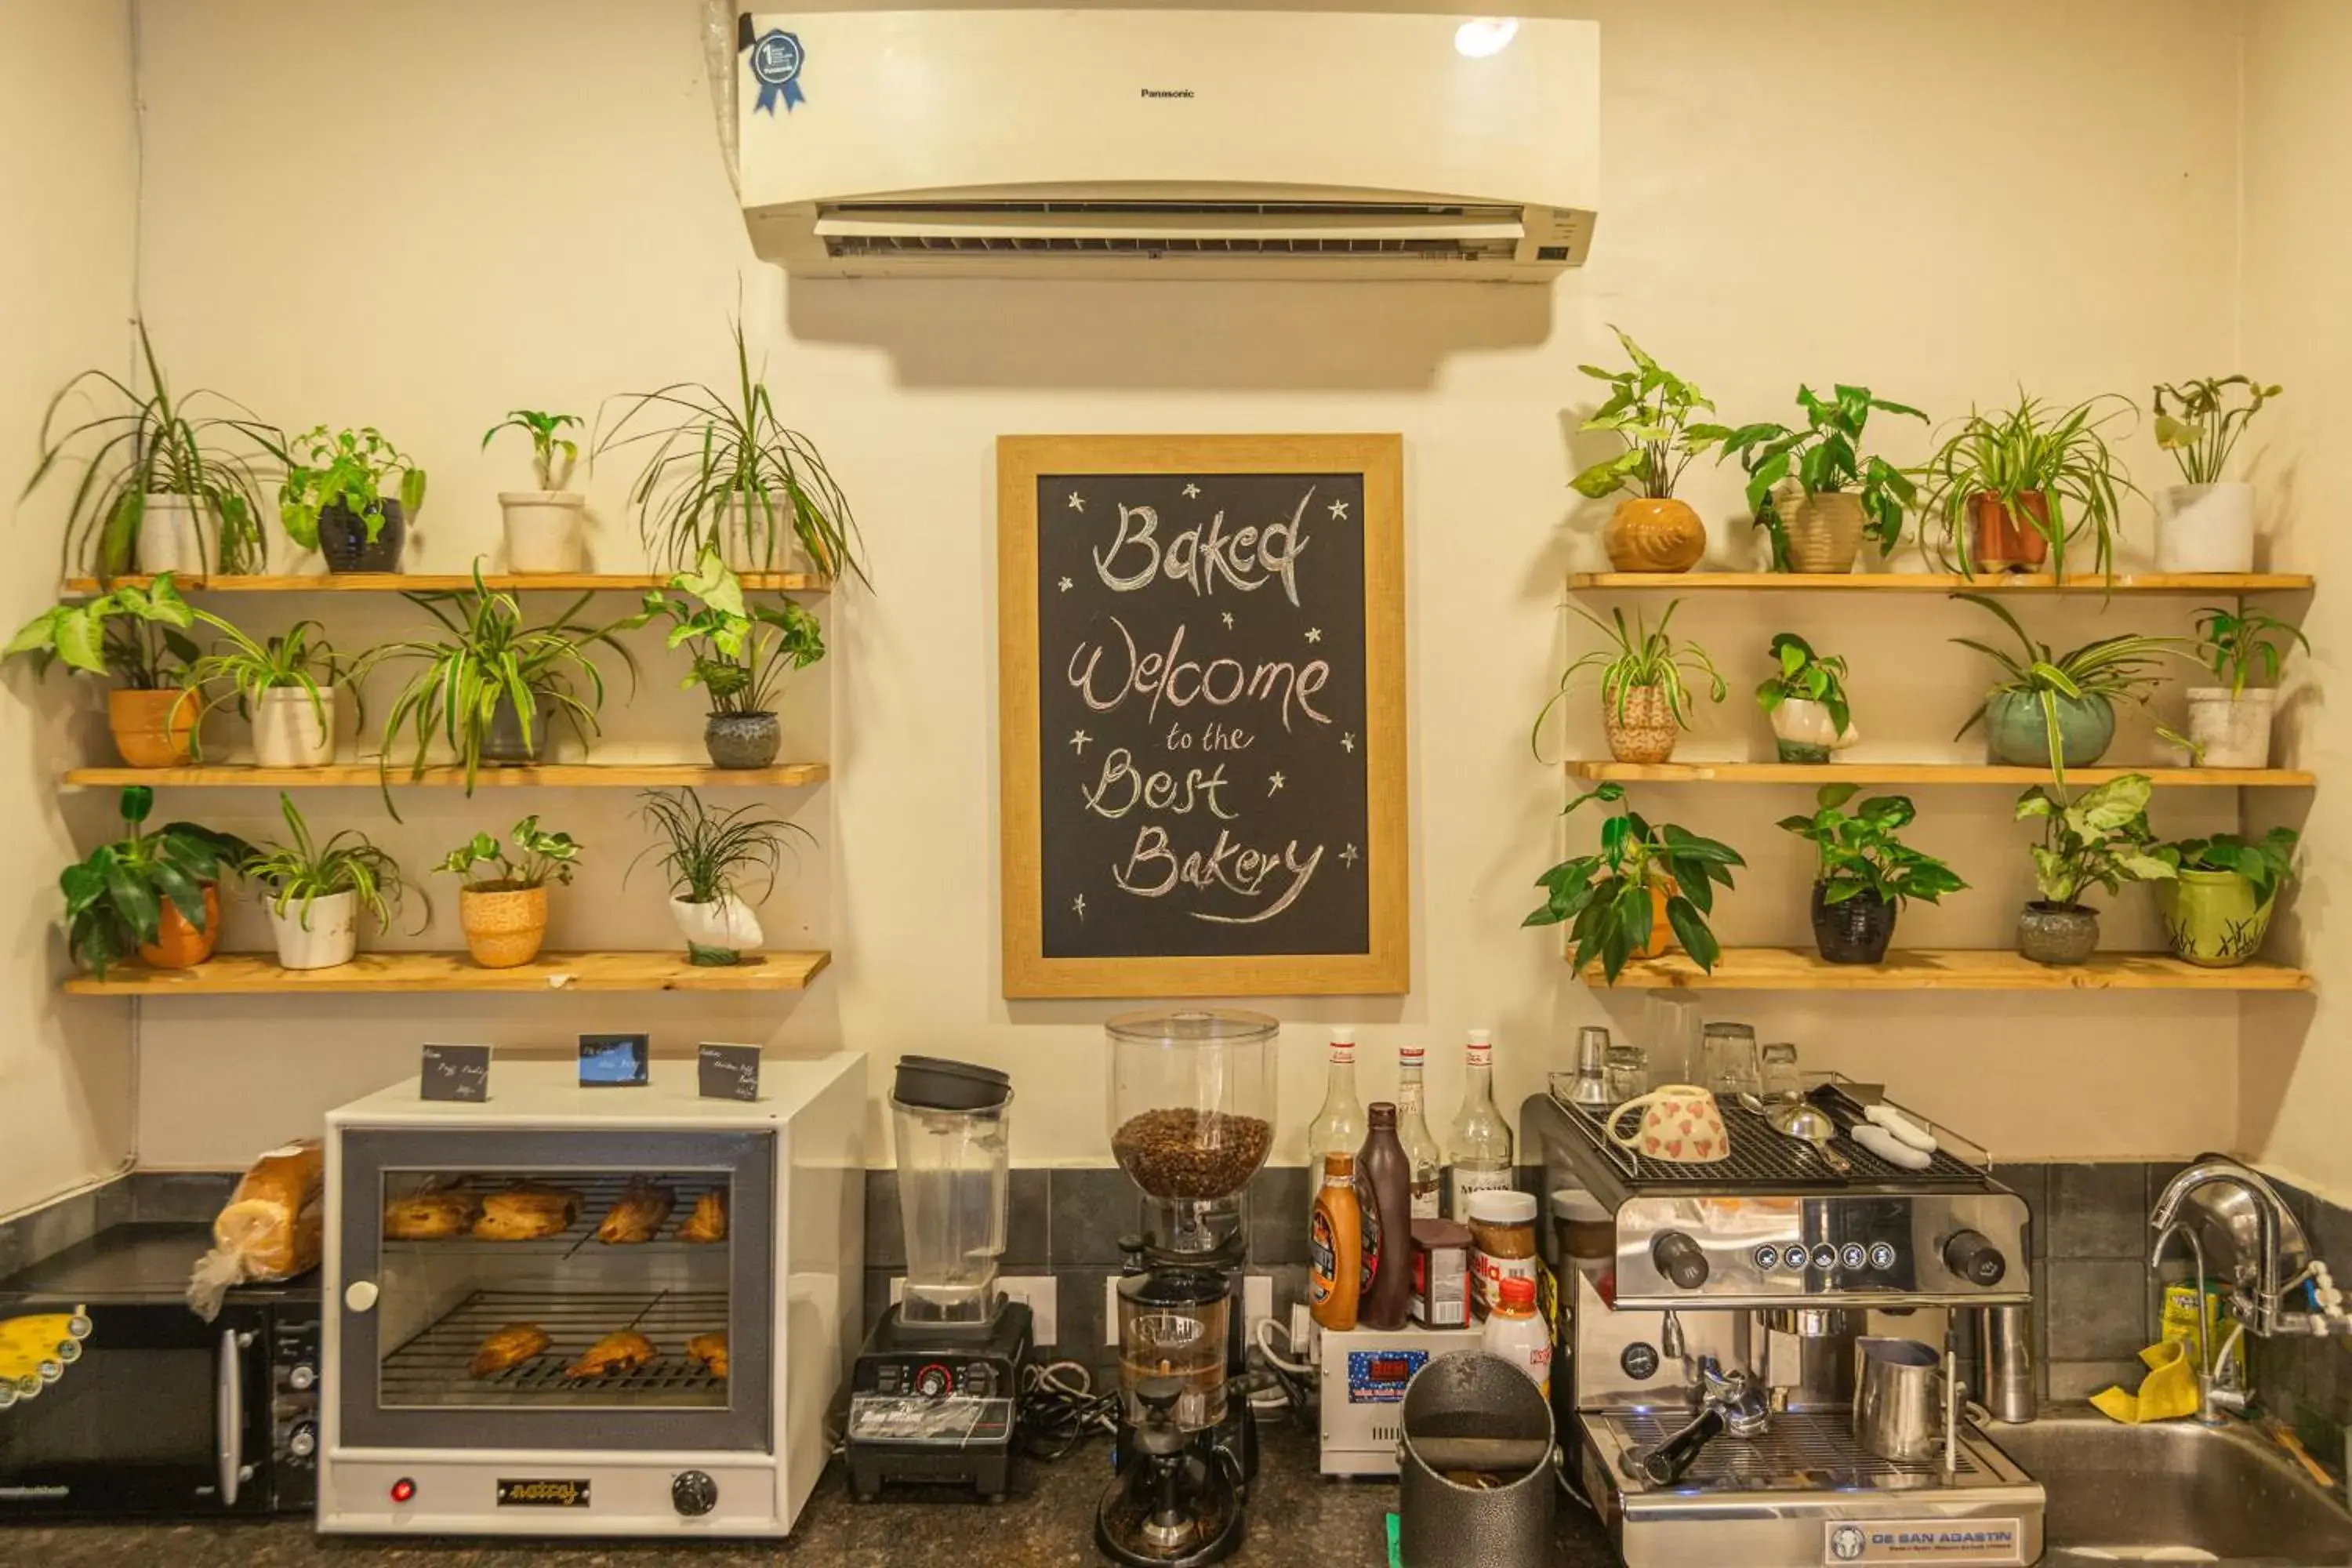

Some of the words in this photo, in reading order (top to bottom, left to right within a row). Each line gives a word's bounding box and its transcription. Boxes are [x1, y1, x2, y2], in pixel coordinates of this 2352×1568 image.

[1141, 88, 1195, 98] Panasonic
[1093, 485, 1316, 608] Baked
[1068, 615, 1332, 732] Welcome
[1167, 722, 1192, 750] to
[1202, 721, 1256, 752] the
[1082, 747, 1240, 818] Best
[1112, 826, 1325, 924] Bakery
